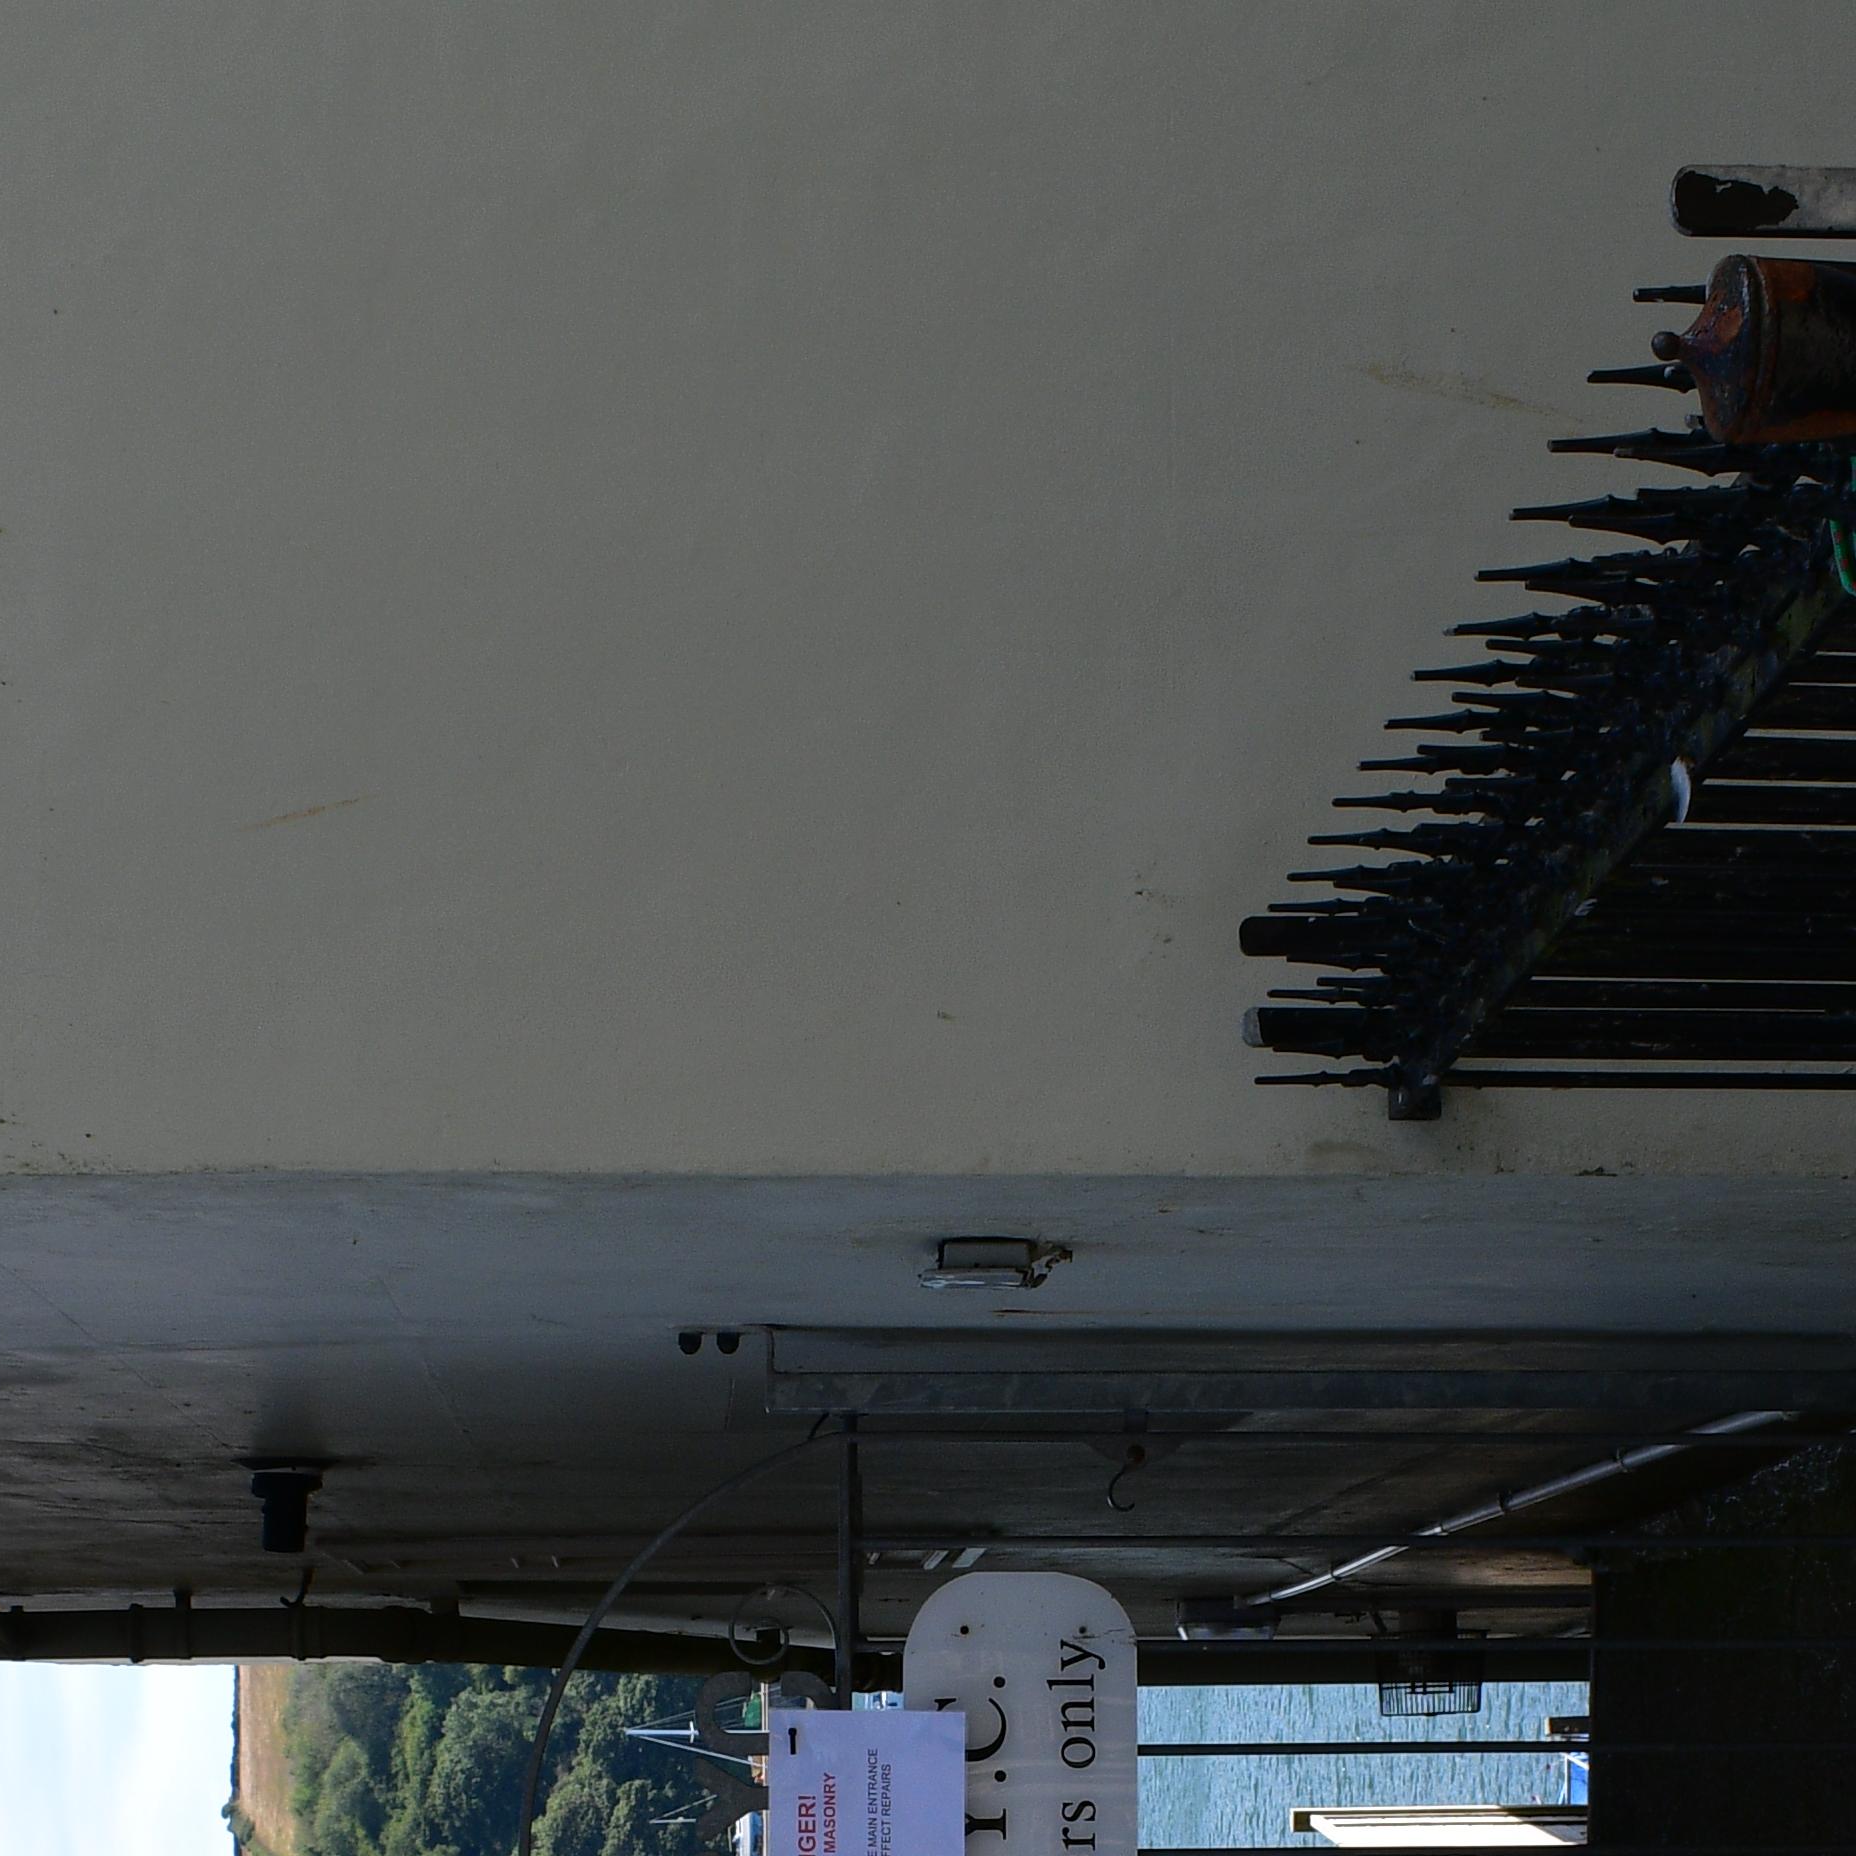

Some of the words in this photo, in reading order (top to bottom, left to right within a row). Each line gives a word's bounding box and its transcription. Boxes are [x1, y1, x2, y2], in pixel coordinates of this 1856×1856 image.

[1046, 1638, 1106, 1768] only
[824, 1772, 836, 1853] MASONRY
[868, 1749, 878, 1813] ENTRANCE
[881, 1764, 891, 1816] REPAIRS
[868, 1817, 878, 1847] MAIN
